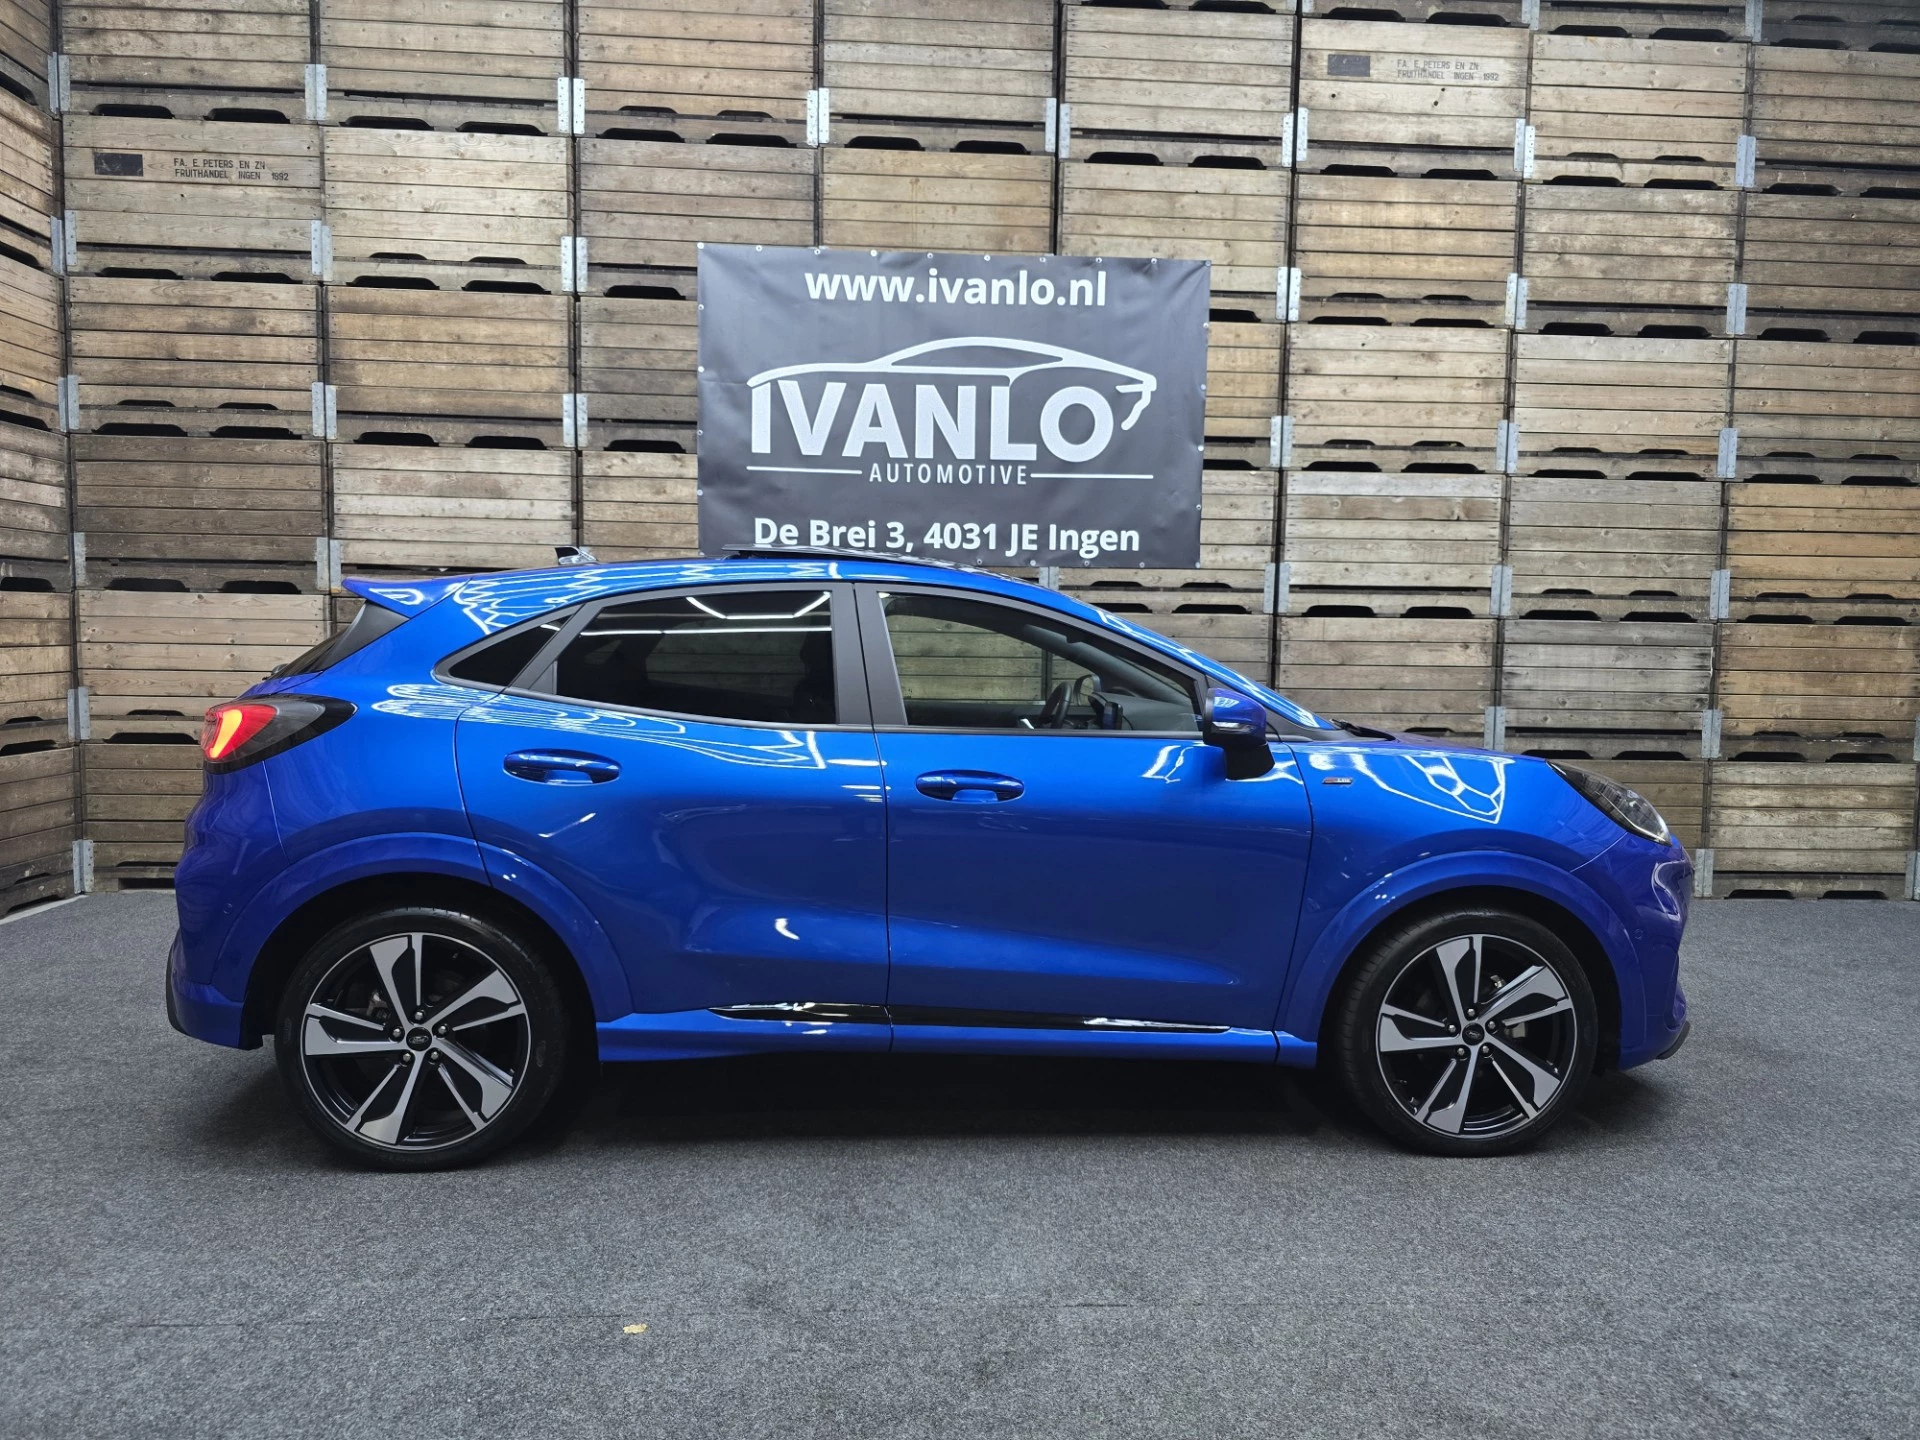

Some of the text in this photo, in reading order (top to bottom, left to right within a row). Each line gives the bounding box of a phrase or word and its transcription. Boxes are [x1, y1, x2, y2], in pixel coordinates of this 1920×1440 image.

[1423, 60, 1451, 70] PETERS
[1455, 61, 1465, 70] EN
[1397, 69, 1445, 80] FRUITHANDEL
[1453, 71, 1474, 80] INGEN
[203, 158, 234, 168] PETERS
[238, 160, 250, 169] EN
[175, 168, 229, 179] FRUITHANDEL
[238, 170, 261, 180] INGEN
[804, 268, 1107, 307] www.ivanlo.nl
[750, 379, 1115, 463] IVANLO
[868, 462, 1027, 486] AUTOMOTIVE
[754, 517, 1140, 560] De Brei 3, 4031 JE Ingen
